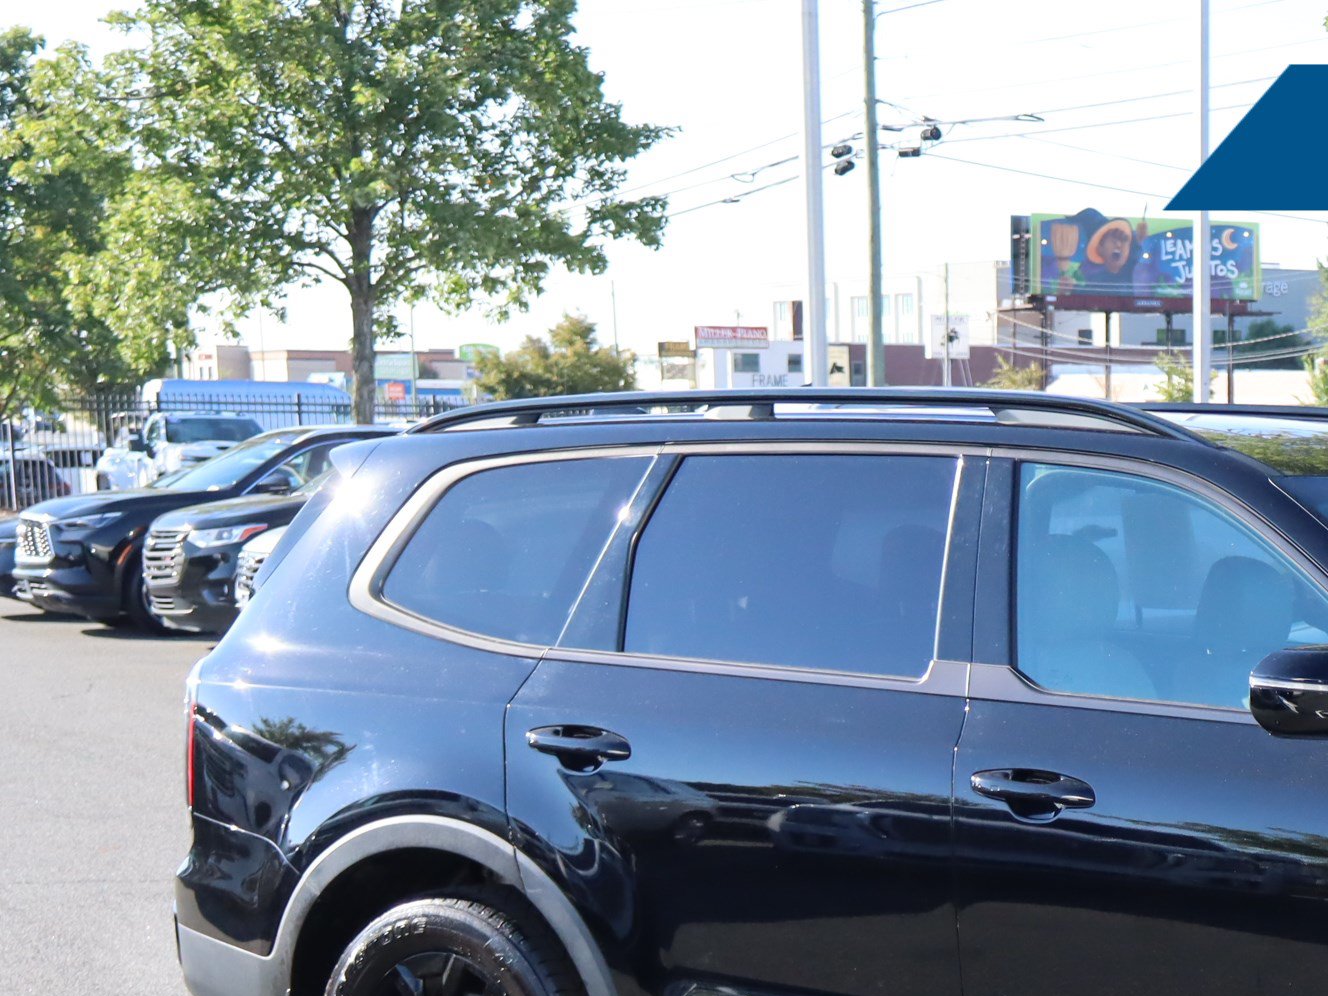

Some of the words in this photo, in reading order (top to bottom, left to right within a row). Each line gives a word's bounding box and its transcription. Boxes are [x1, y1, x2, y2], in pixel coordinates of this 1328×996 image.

[1161, 239, 1223, 260] LEAMS
[1171, 260, 1238, 283] JUTOS
[752, 374, 788, 387] FRAME
